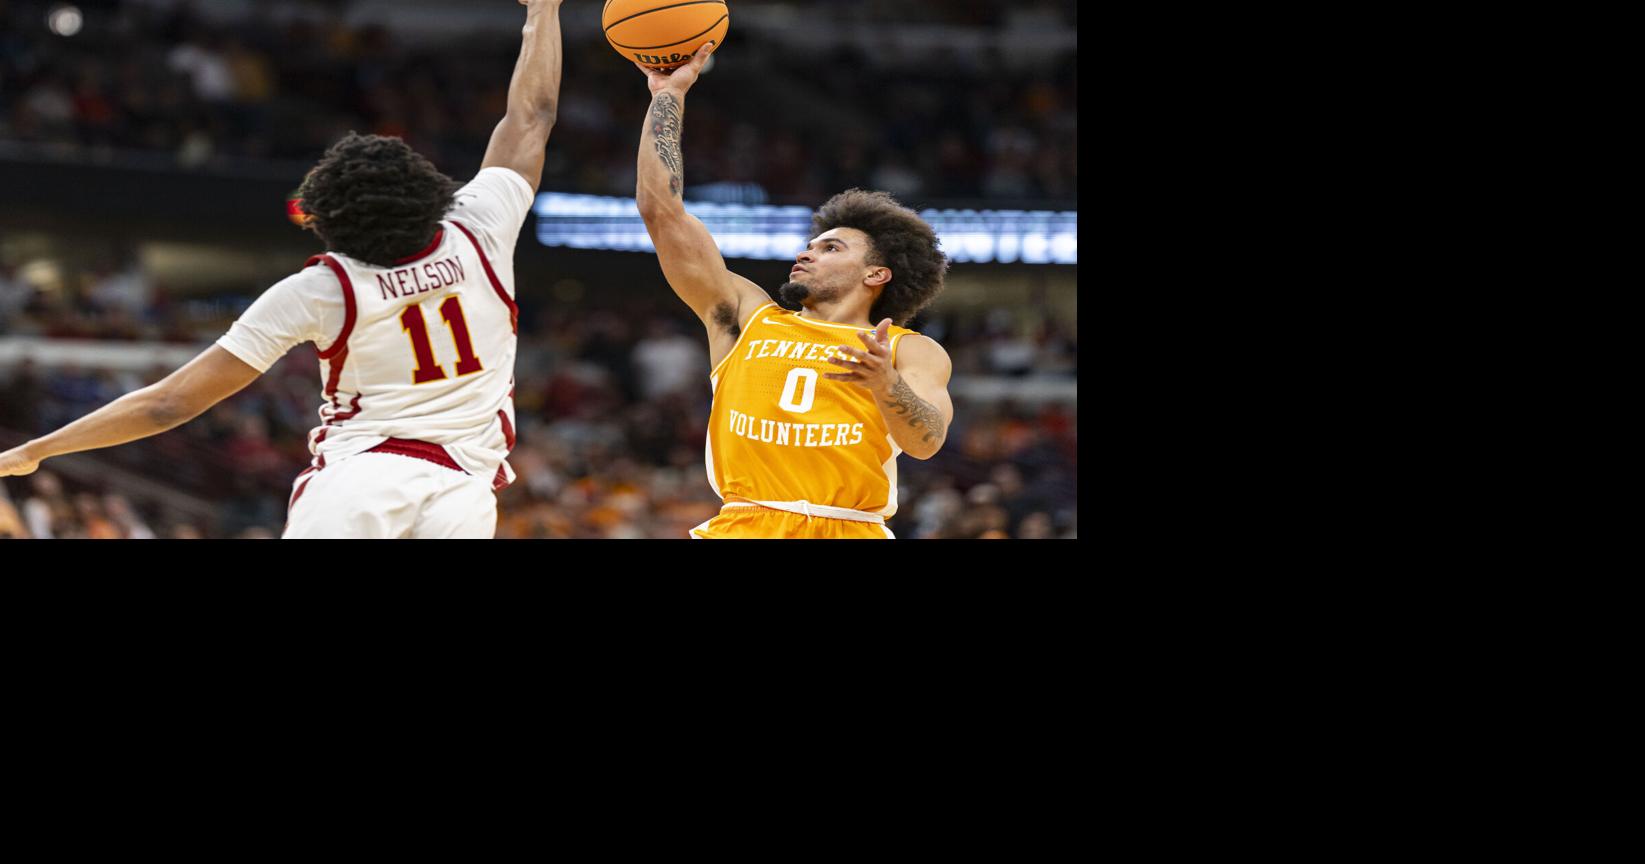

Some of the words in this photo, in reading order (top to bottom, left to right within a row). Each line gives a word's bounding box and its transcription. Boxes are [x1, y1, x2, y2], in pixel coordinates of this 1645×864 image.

[633, 40, 715, 64] Wils
[376, 256, 465, 300] NELSON
[399, 292, 484, 385] 11
[745, 339, 858, 363] TENNES
[778, 367, 818, 414] 0
[729, 409, 864, 447] VOLUNTEERS
